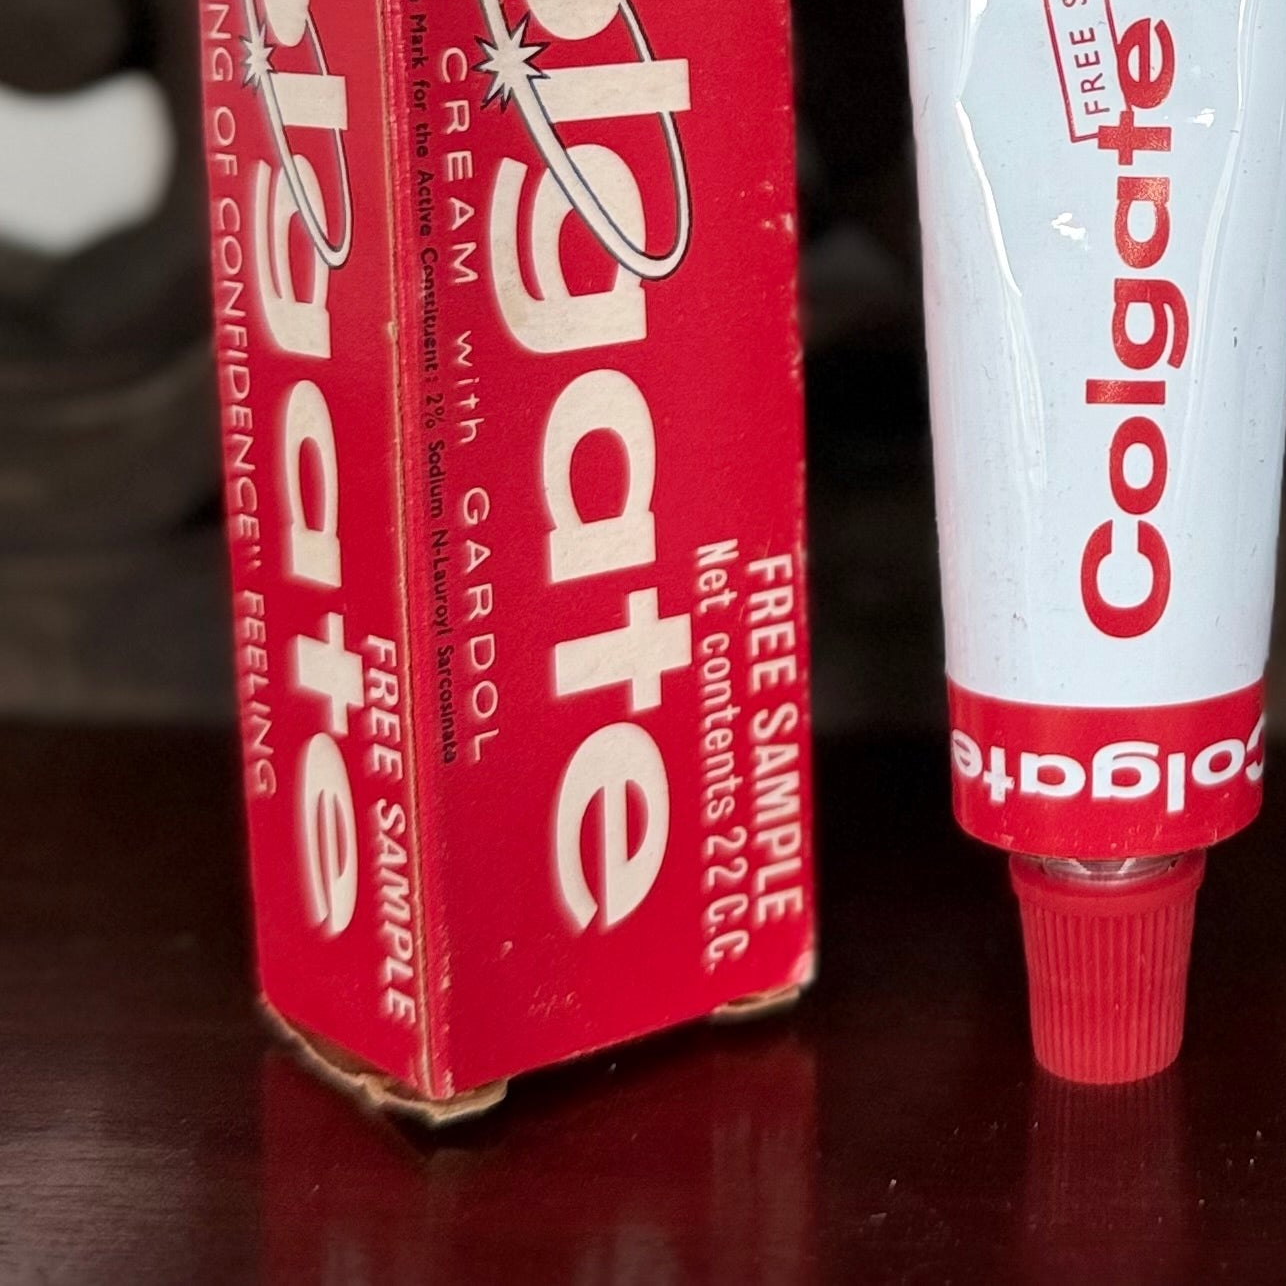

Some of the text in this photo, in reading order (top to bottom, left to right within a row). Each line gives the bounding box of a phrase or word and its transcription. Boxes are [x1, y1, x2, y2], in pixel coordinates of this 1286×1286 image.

[410, 15, 427, 68] Mark
[1069, 27, 1110, 116] FREE
[213, 107, 237, 176] OF
[412, 79, 431, 112] for
[415, 122, 433, 159] the
[417, 170, 435, 235] Active
[441, 48, 478, 284] CREAM
[1081, 18, 1189, 639] Colgate
[218, 197, 262, 570] CONFIDENCE"
[425, 393, 444, 428] 2%
[455, 332, 484, 443] with
[427, 441, 448, 517] Sodium
[430, 530, 453, 635] N-Lauroyl
[462, 488, 500, 761] GARDOL
[696, 538, 740, 613] Net
[241, 590, 276, 795] FEELING
[701, 632, 744, 820] contents
[747, 553, 804, 929] FREE SAMPLE
[367, 635, 415, 1023] FREE SAMPLE
